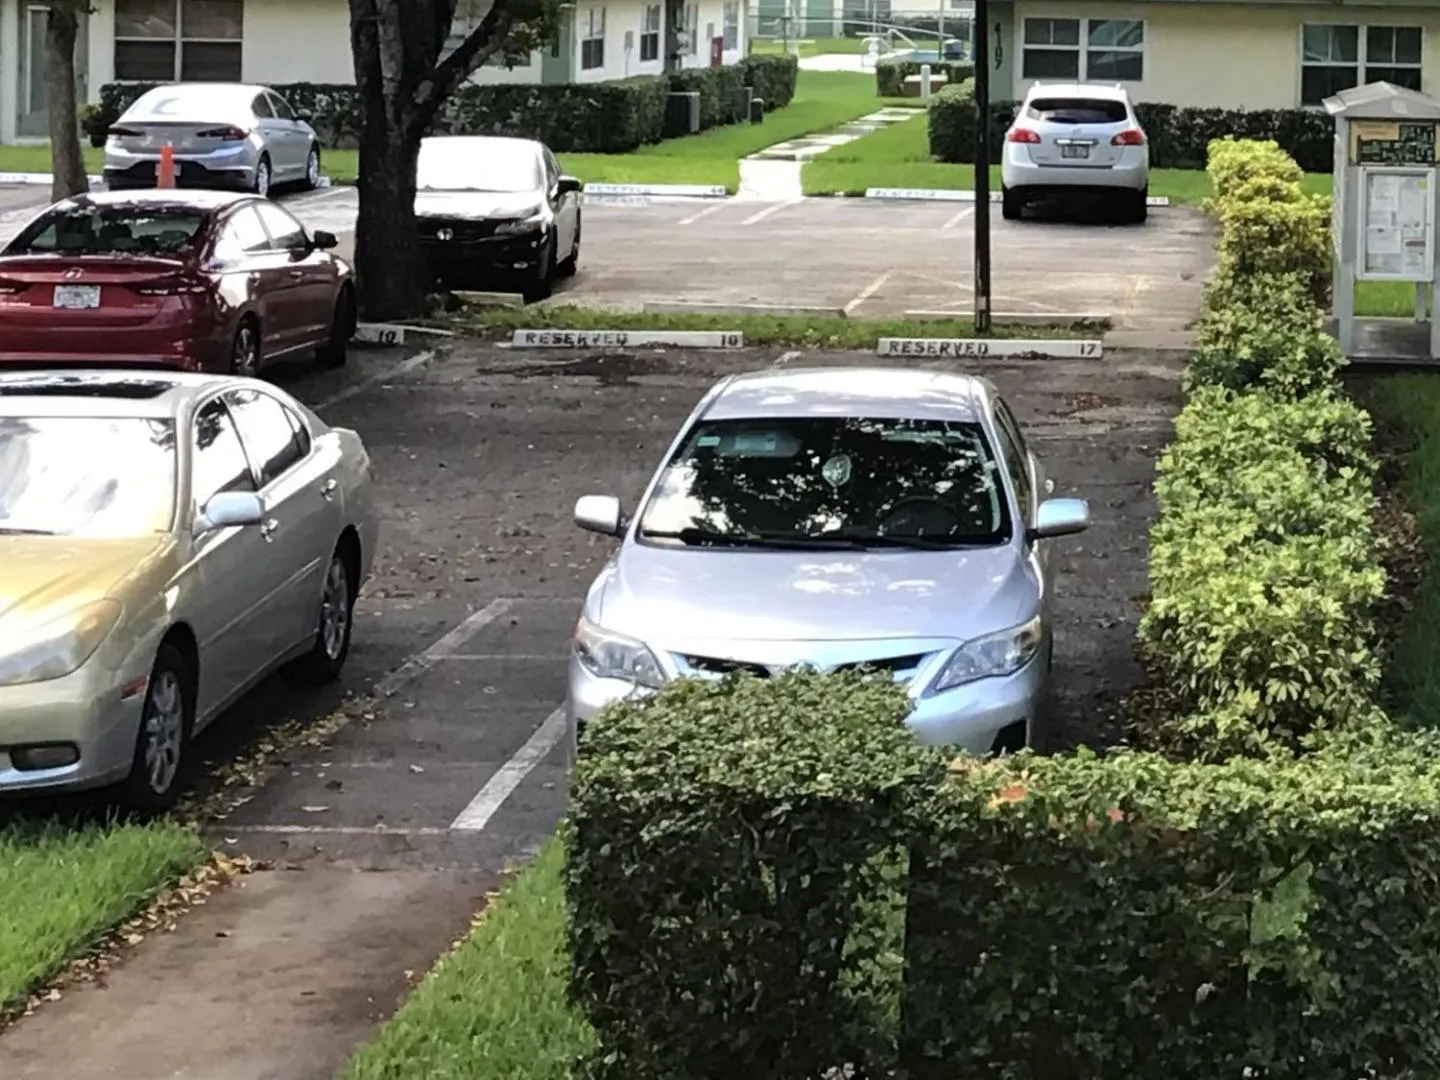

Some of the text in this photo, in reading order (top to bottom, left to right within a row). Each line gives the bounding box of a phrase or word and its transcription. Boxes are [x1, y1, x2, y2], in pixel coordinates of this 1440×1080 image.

[525, 332, 629, 346] RESERVED
[889, 340, 1096, 356] RESERVED 17
